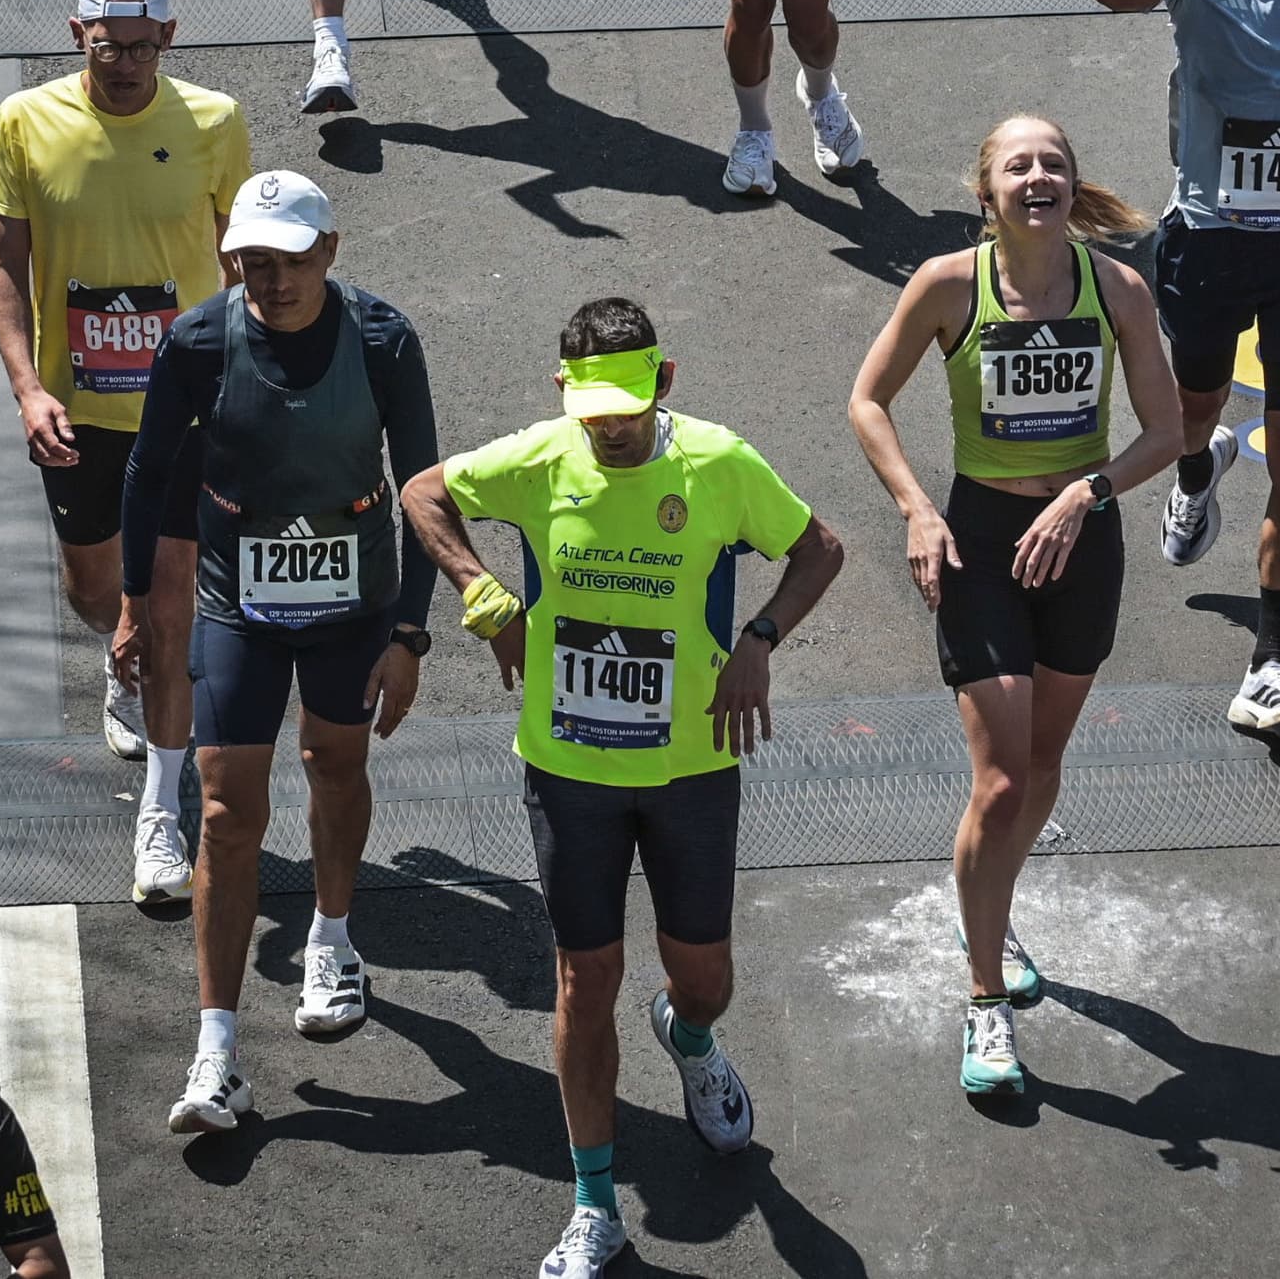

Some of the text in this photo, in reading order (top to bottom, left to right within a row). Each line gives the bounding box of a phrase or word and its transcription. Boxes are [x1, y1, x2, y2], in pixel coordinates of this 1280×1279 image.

[83, 314, 163, 352] 6489
[992, 351, 1094, 396] 13582
[1024, 419, 1051, 427] BOSTON
[1052, 414, 1088, 425] MARATHON
[250, 540, 350, 583] 12029
[629, 538, 684, 566] CIBENO
[245, 588, 253, 597] 4
[561, 571, 675, 595] AUTOTORINO
[564, 651, 664, 705] 11409
[558, 697, 564, 706] 3
[591, 725, 617, 735] BOSTON
